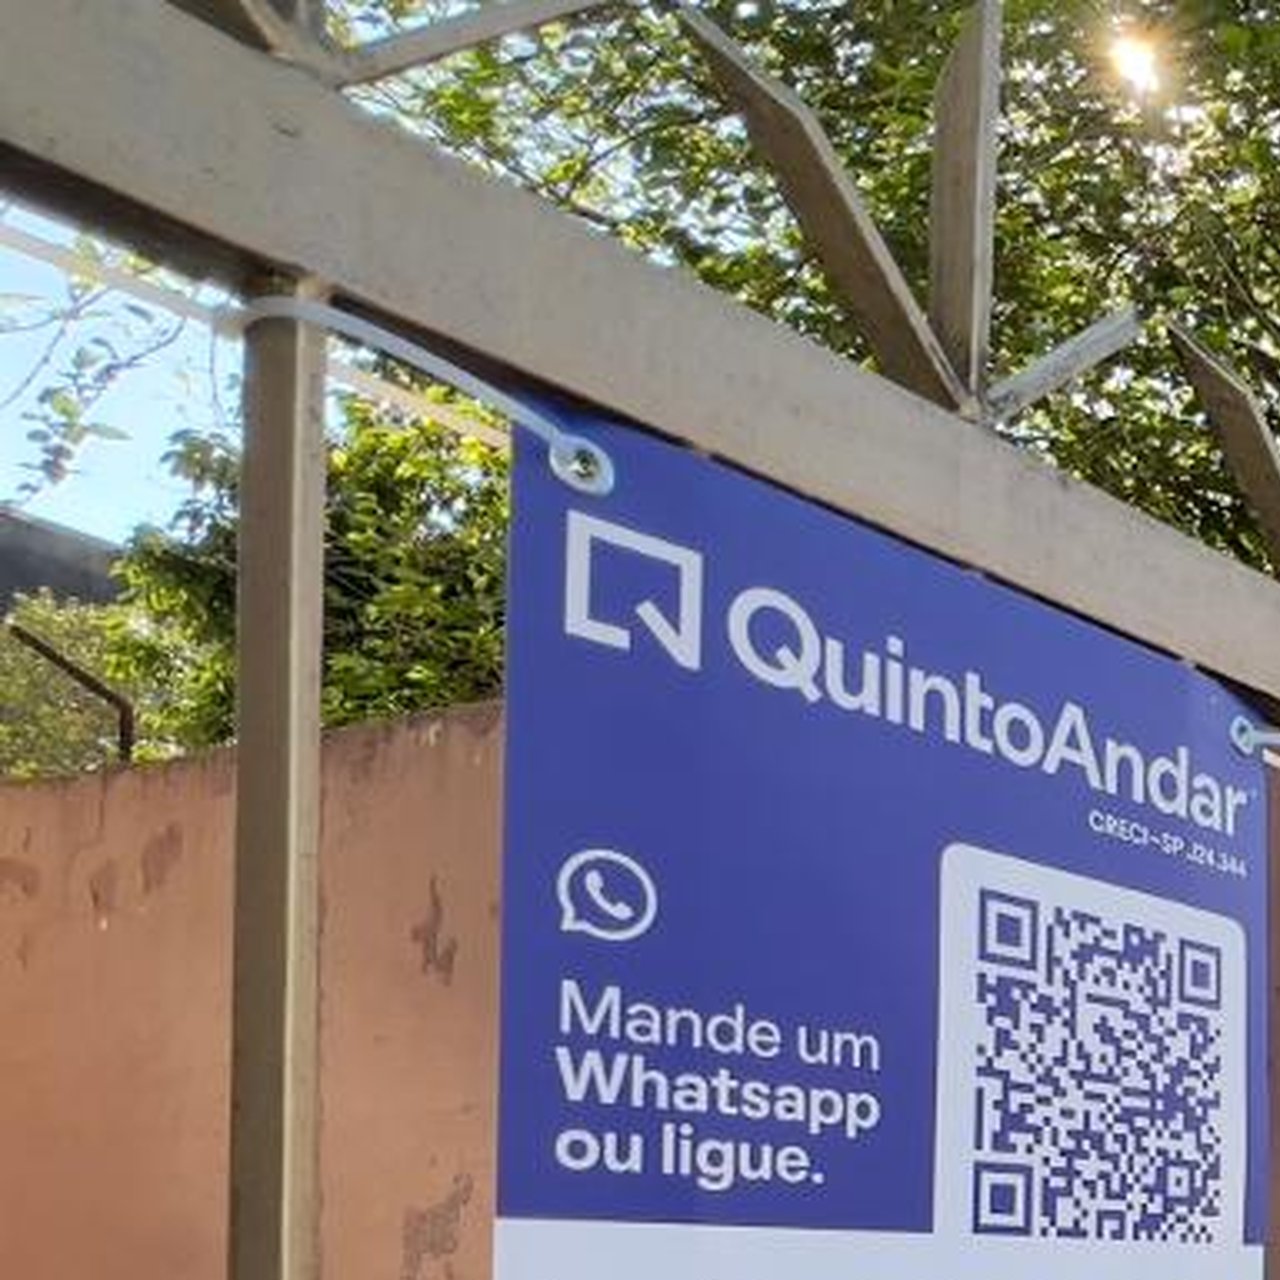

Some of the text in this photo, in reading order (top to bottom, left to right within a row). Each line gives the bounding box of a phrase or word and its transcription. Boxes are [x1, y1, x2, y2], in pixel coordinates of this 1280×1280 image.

[728, 586, 1246, 836] QuintoAndar
[1089, 809, 1184, 855] CRECI-SP
[560, 980, 880, 1070] Mande um
[555, 1048, 881, 1138] Whatsapp
[555, 1126, 824, 1188] ou ligue.
